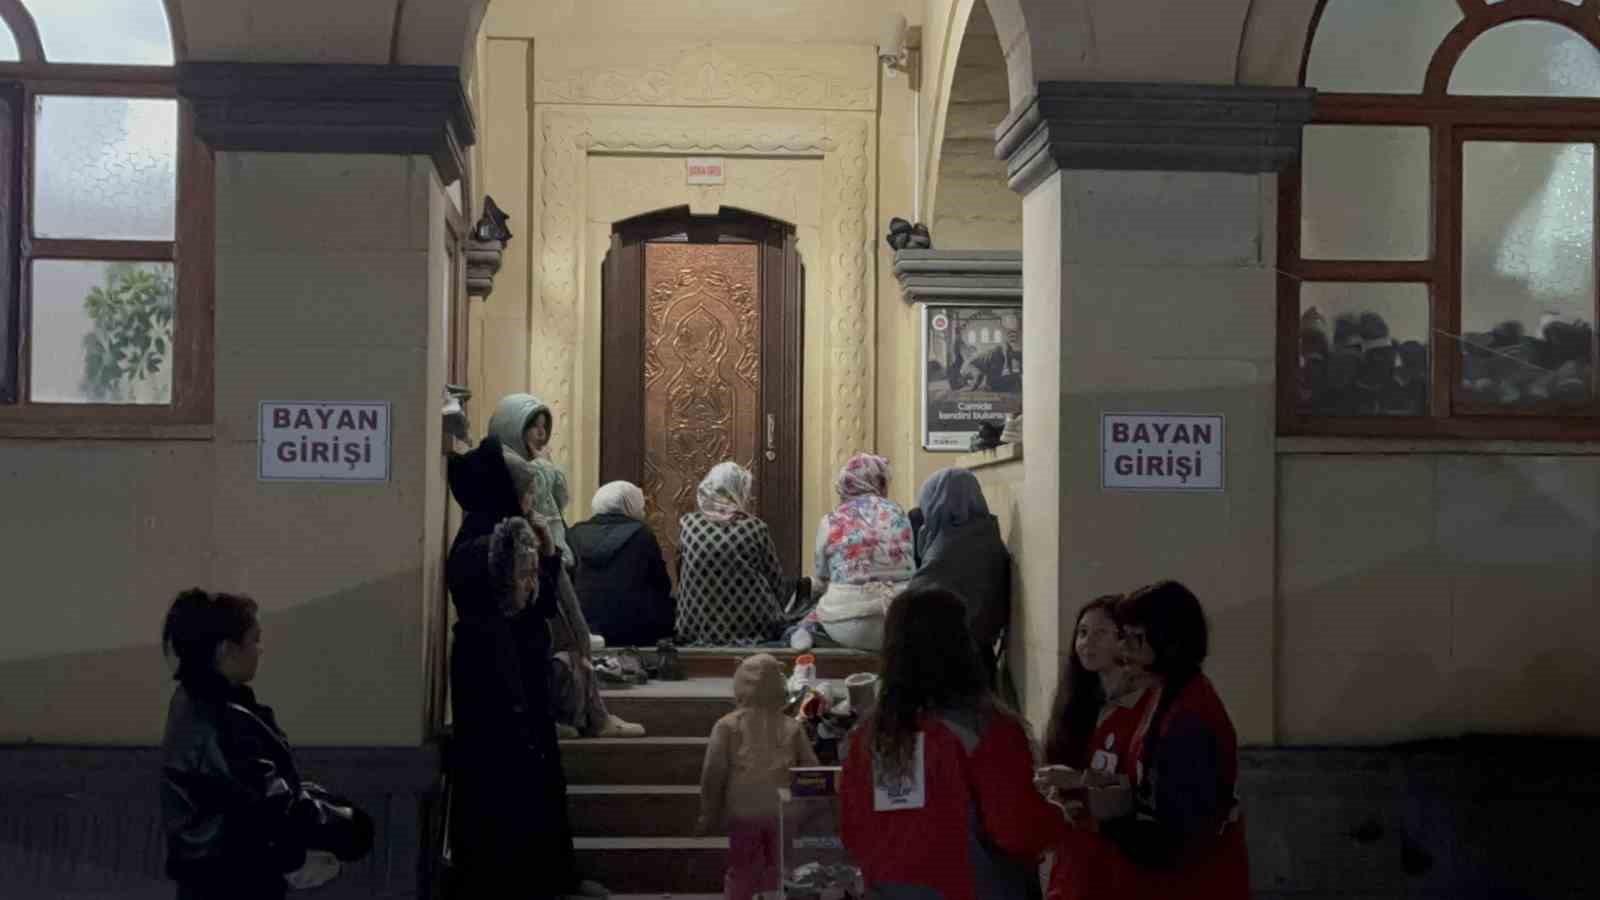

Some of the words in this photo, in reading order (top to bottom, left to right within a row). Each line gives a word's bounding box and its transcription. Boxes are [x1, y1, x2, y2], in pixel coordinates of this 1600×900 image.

[272, 407, 378, 430] BAYAN
[1112, 422, 1212, 444] BAYAN
[277, 435, 371, 470] GİRİŞİ
[1114, 448, 1202, 484] GİRİŞİ
